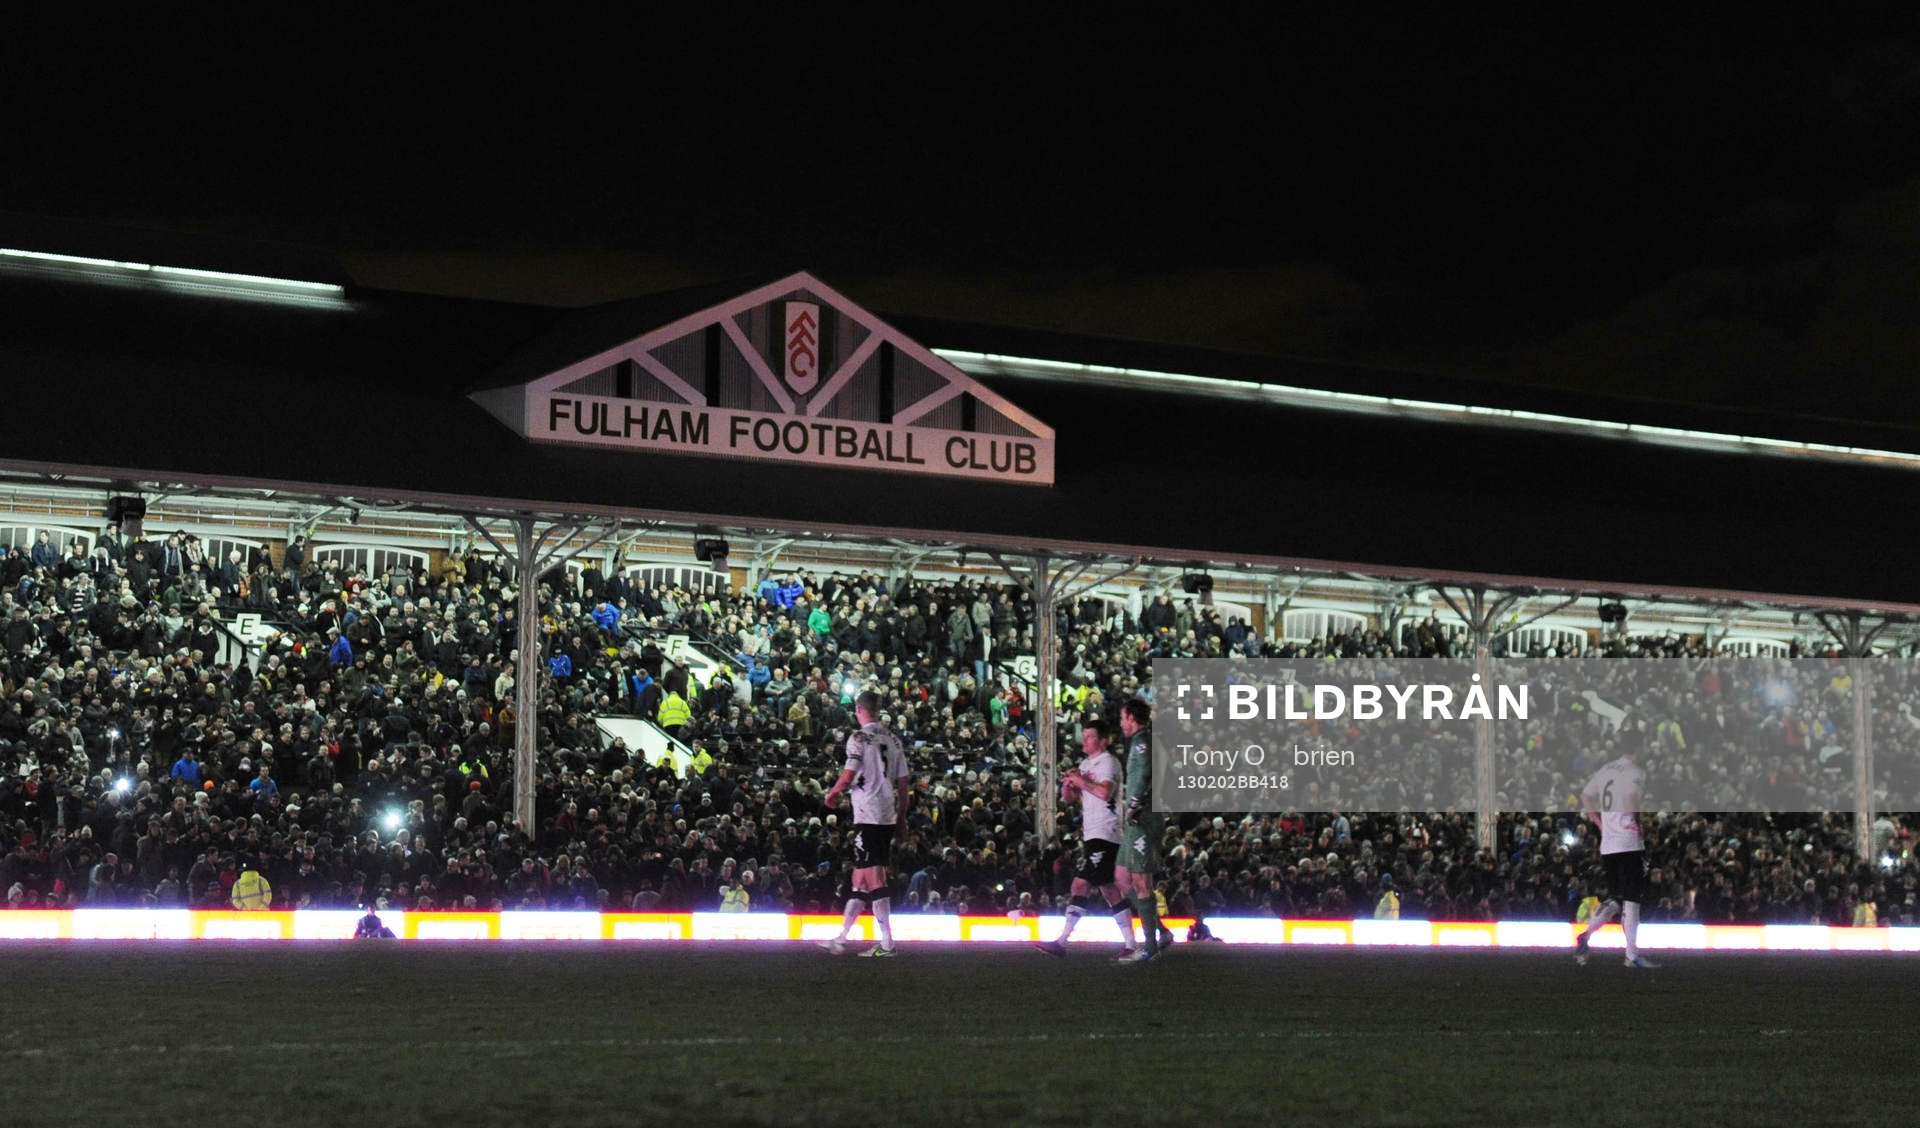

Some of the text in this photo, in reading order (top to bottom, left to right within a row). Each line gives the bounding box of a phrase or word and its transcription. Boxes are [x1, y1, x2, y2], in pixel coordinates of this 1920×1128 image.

[788, 311, 816, 377] FFC
[549, 398, 1036, 474] FULHAM FOOTBALL CLUB
[241, 618, 254, 635] E
[672, 639, 682, 655] F
[1019, 660, 1030, 675] G
[1602, 779, 1614, 813] 6
